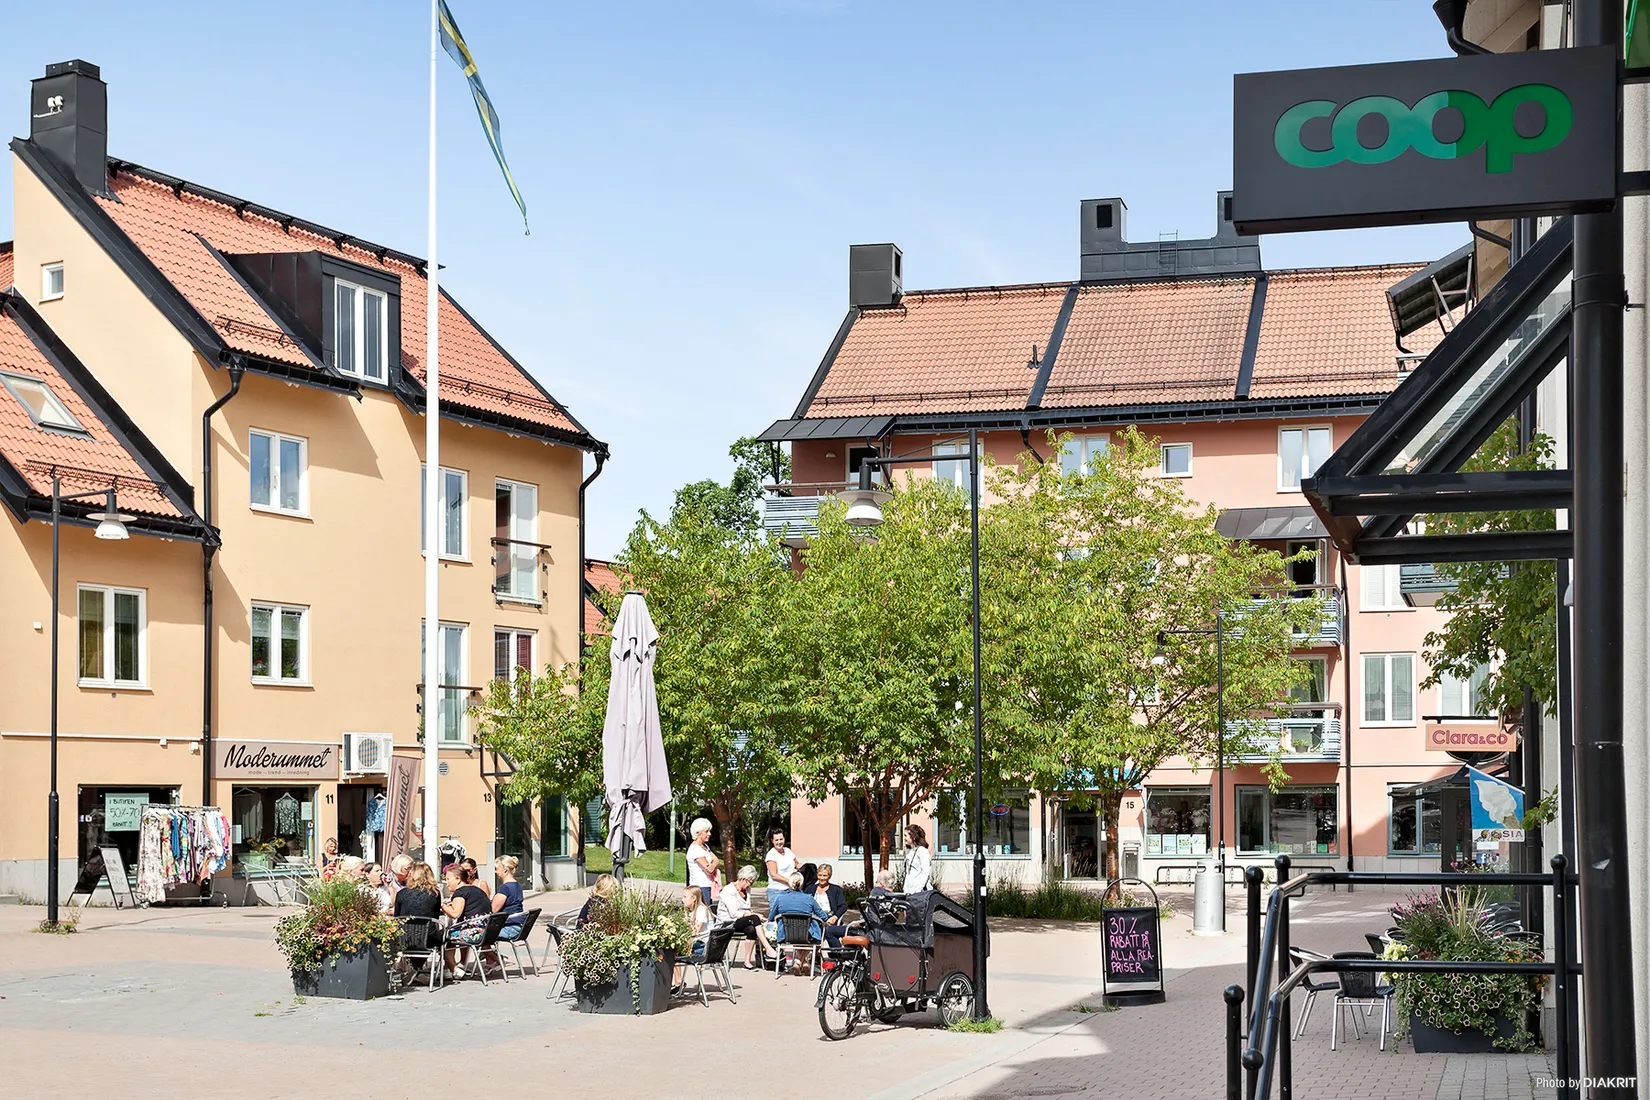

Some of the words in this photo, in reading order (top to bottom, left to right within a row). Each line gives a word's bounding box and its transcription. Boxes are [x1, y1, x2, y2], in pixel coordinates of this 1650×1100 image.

[1273, 83, 1574, 174] coop
[1432, 730, 1508, 745] Clara&co
[224, 744, 331, 769] Moderummet
[325, 794, 334, 805] 11
[484, 792, 492, 803] 13
[1126, 801, 1135, 809] 15
[1109, 916, 1126, 935] 30
[1109, 934, 1140, 948] RABATT
[1140, 930, 1151, 951] PÅ
[1110, 950, 1136, 961] ALLA
[1111, 961, 1145, 974] PRISER
